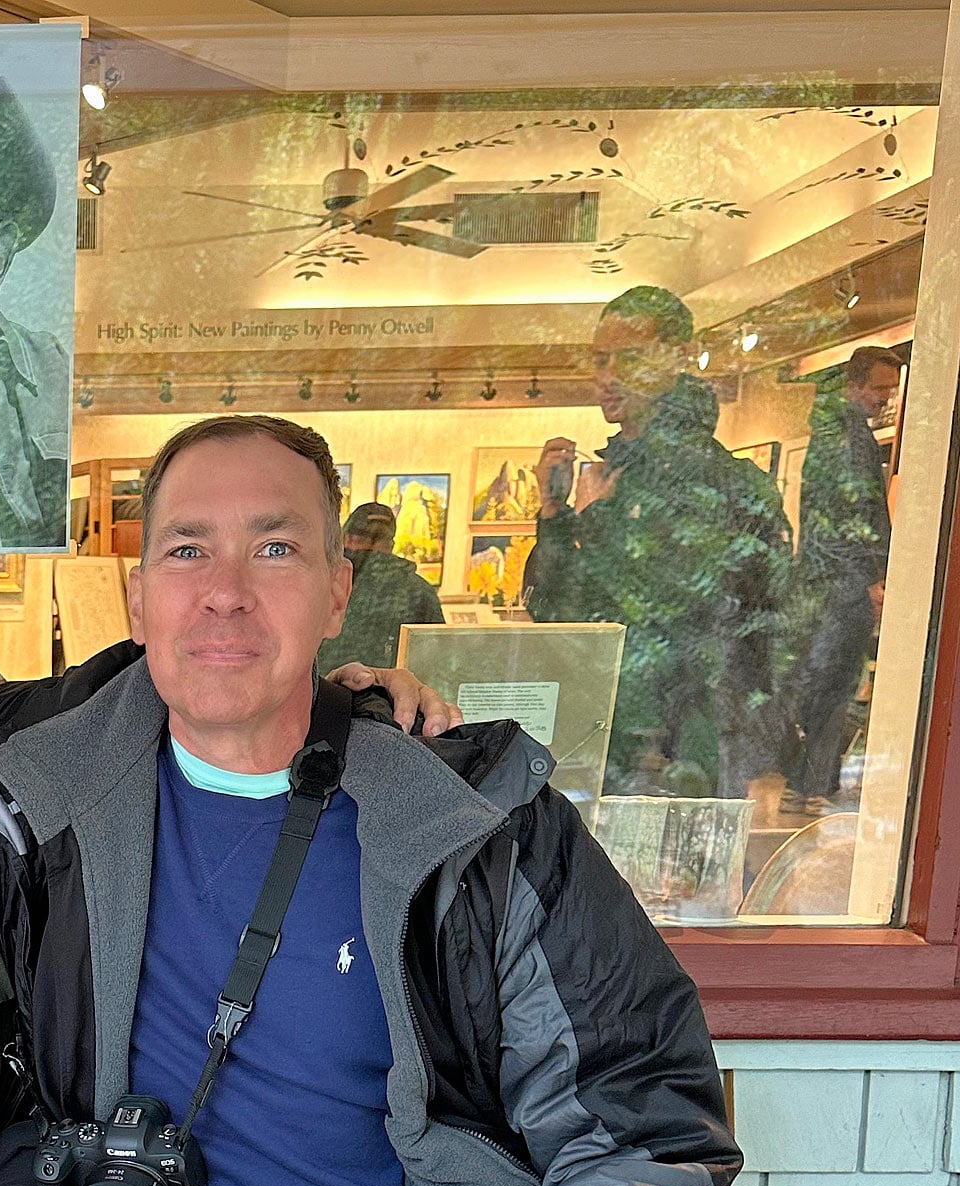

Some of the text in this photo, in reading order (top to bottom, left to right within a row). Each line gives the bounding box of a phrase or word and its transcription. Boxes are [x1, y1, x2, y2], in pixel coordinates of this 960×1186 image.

[97, 317, 434, 344] High Spirit: New Paintings by Penny Otwell
[106, 1148, 137, 1158] Canon
[160, 1158, 176, 1167] EOS
